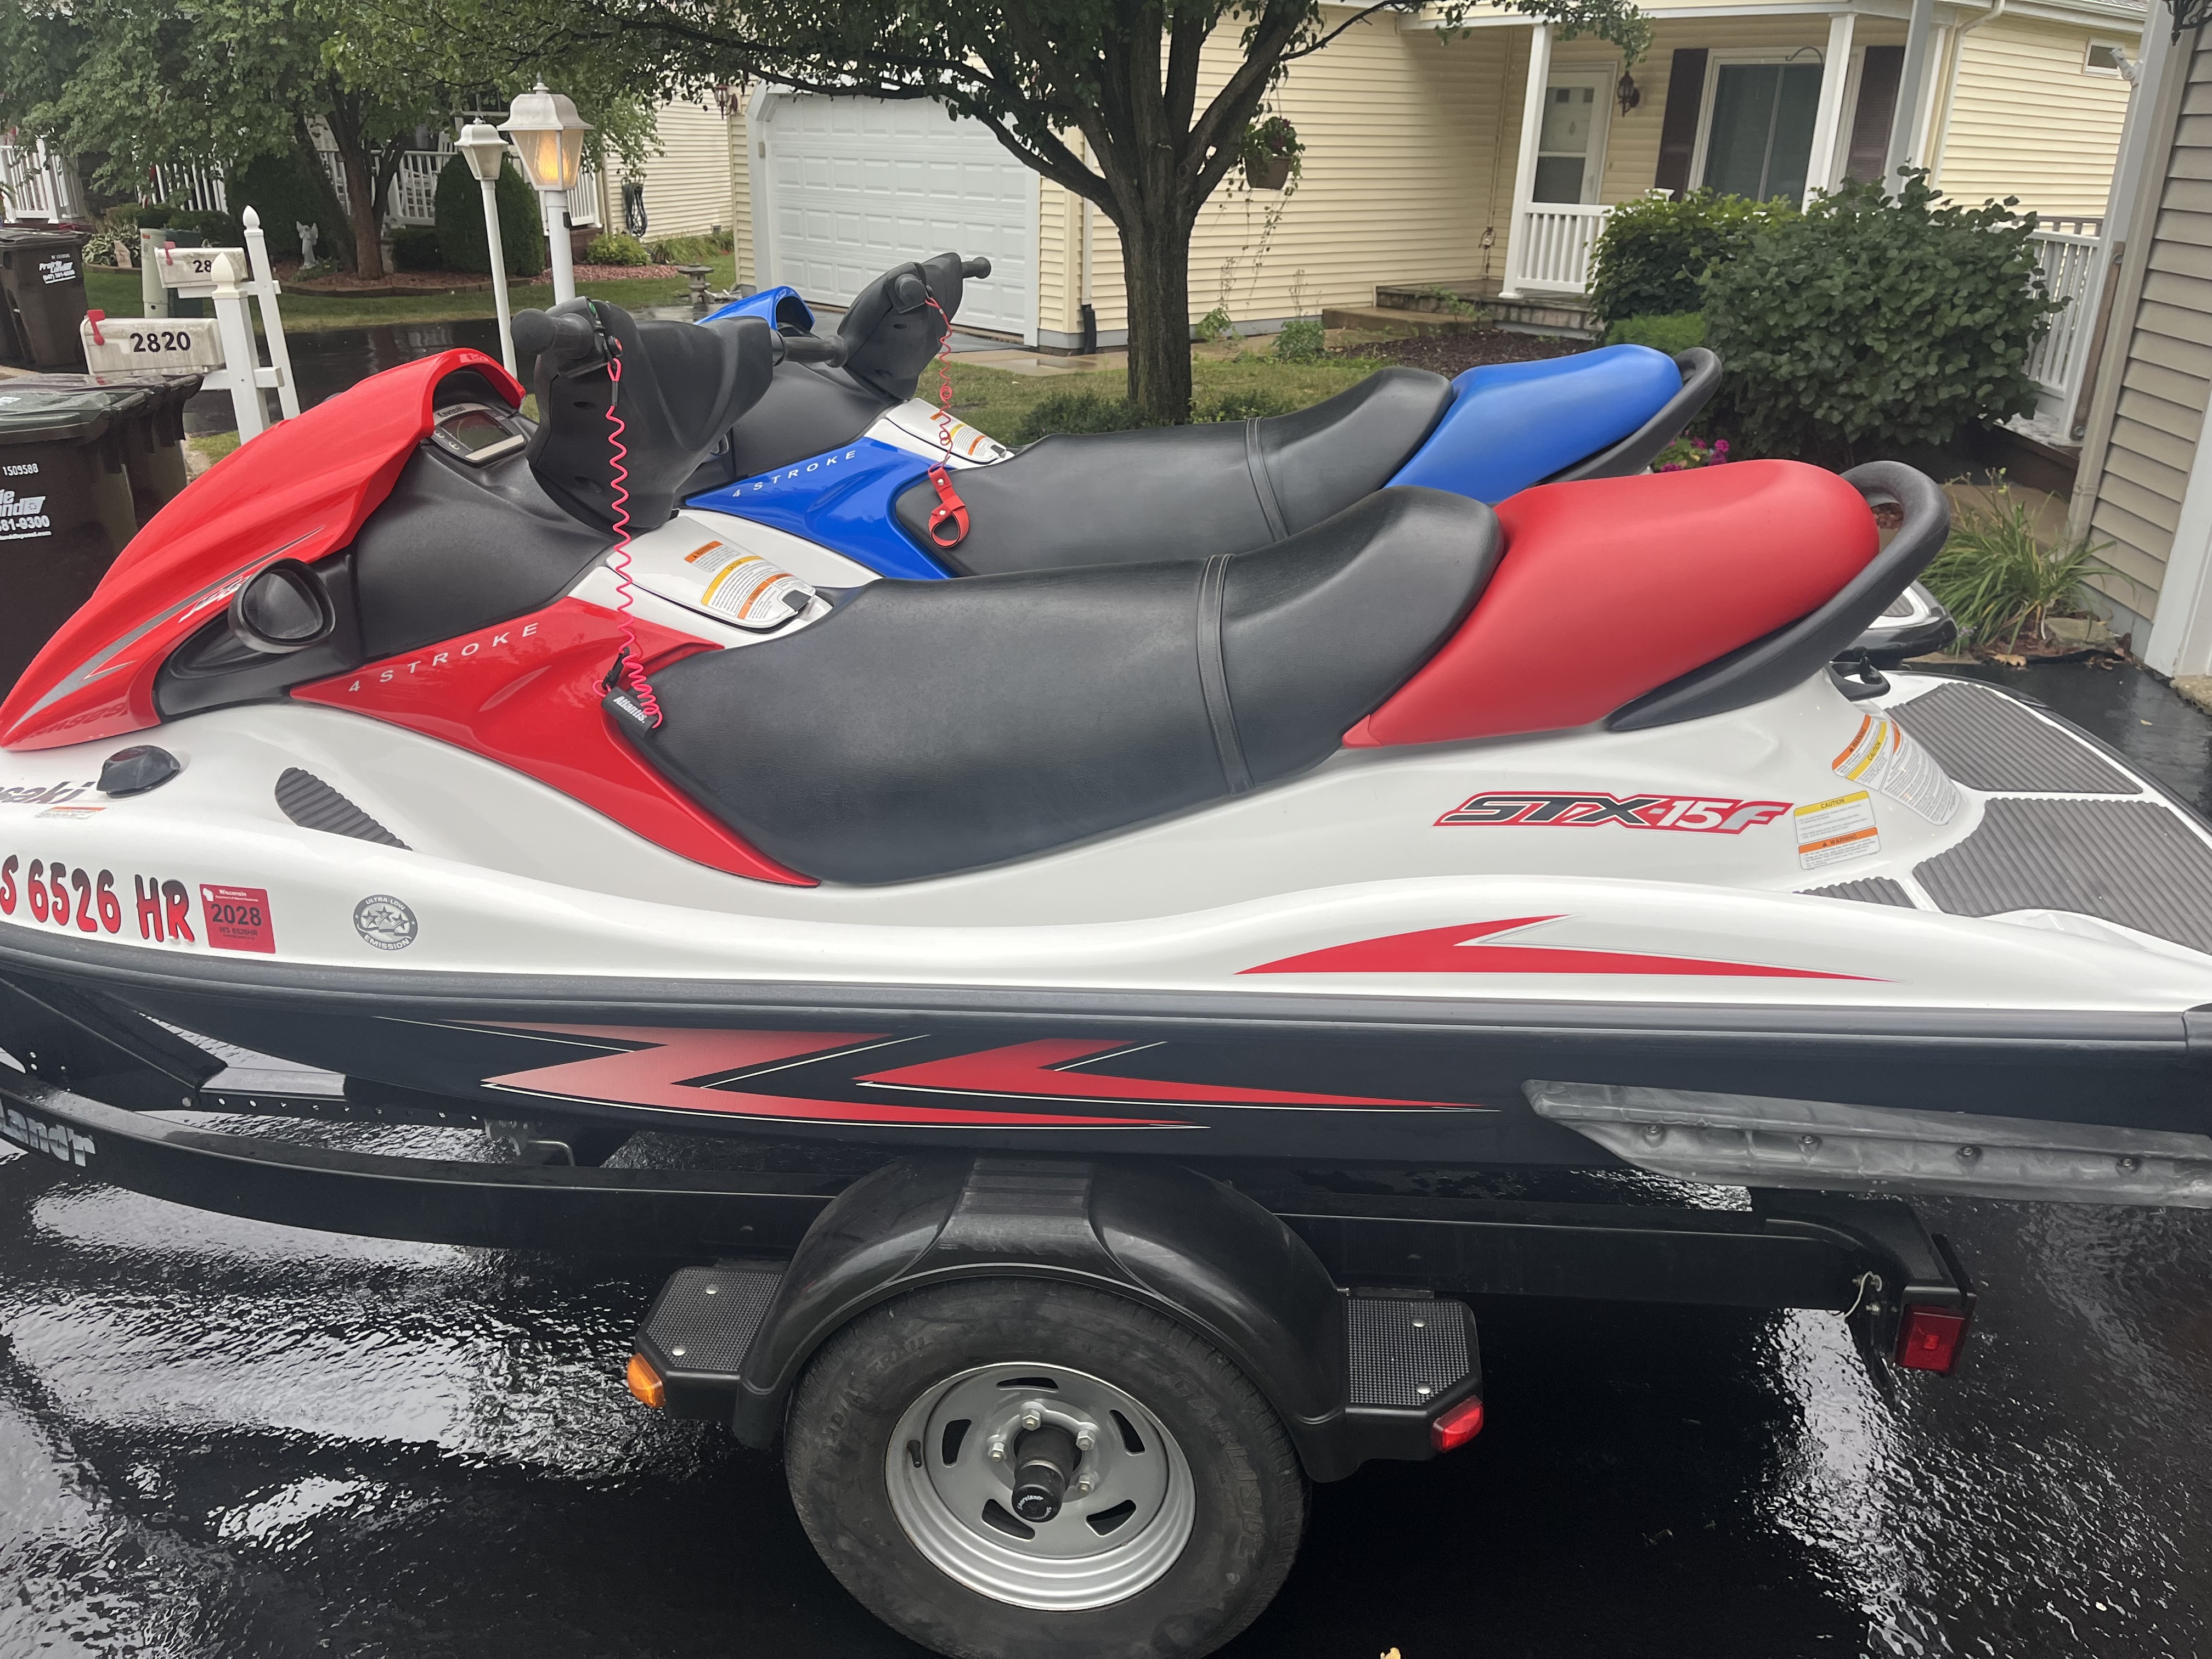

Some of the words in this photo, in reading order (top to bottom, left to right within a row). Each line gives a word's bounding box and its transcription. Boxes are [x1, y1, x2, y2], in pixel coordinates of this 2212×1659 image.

[130, 331, 191, 352] 2820
[436, 405, 466, 418] Kawasaki
[2, 463, 39, 476] 1509588
[732, 489, 741, 498] 4
[753, 450, 856, 491] STROKE
[0, 515, 50, 532] 81-9300
[348, 680, 360, 692] 4
[380, 622, 538, 683] STROKE
[1867, 740, 1881, 761] CAUTION
[0, 781, 97, 804] saki
[1821, 798, 1845, 809] CAUTION
[1830, 834, 1858, 845] WARNING
[28, 859, 121, 934] 6526
[135, 874, 195, 944] HR
[218, 889, 247, 897] Wisconsin
[211, 903, 262, 927] 2028
[364, 934, 410, 950] EMISSION
